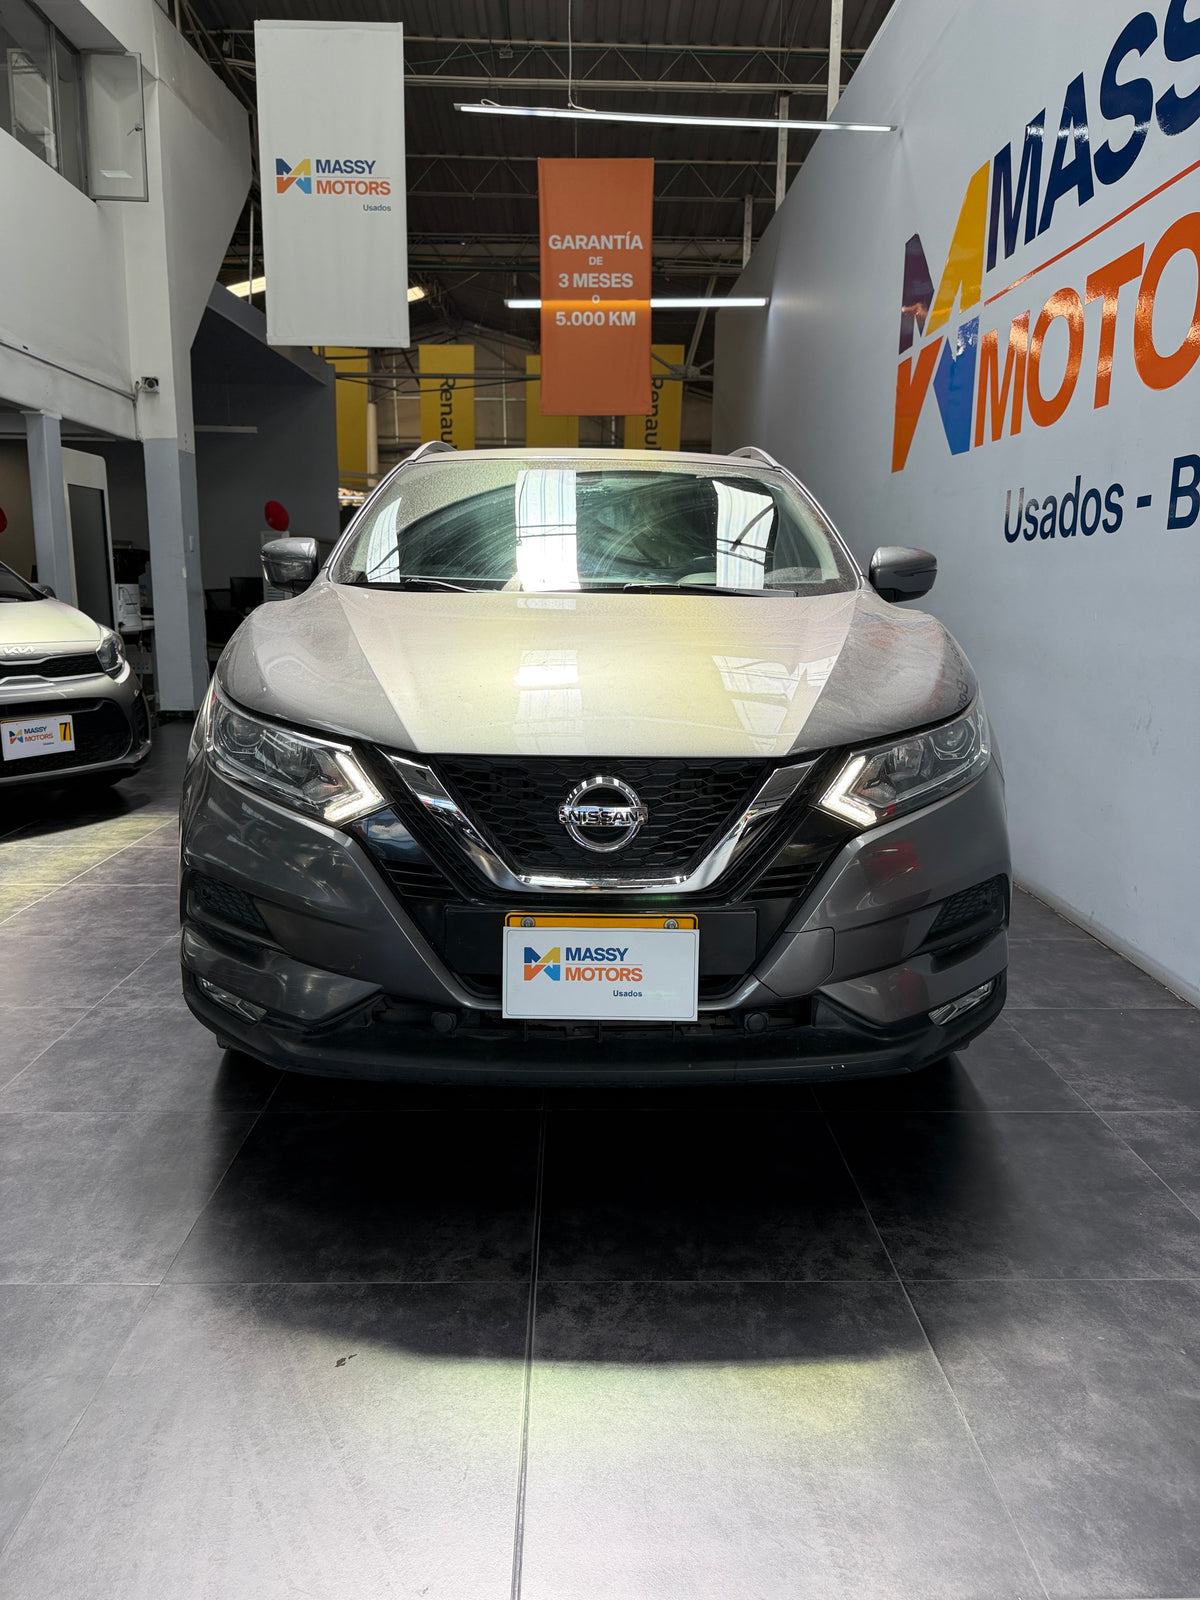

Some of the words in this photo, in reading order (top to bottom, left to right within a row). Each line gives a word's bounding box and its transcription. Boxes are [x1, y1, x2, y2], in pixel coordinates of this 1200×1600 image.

[315, 159, 376, 174] MASSY
[316, 180, 391, 196] MOTORS
[363, 204, 392, 212] Usados
[548, 231, 644, 250] GARANTÍA
[588, 256, 603, 266] DE
[558, 273, 569, 288] 3
[573, 273, 634, 288] MESES
[555, 311, 605, 326] 5.000
[609, 311, 636, 326] KM
[440, 376, 457, 449] Renau
[1004, 475, 1124, 543] Usados
[24, 726, 47, 734] MASSY
[25, 733, 54, 743] MOTORS
[568, 810, 639, 822] NISSAN
[565, 947, 629, 962] MASSY
[565, 967, 643, 982] MOTORS
[612, 989, 643, 998] Usados
